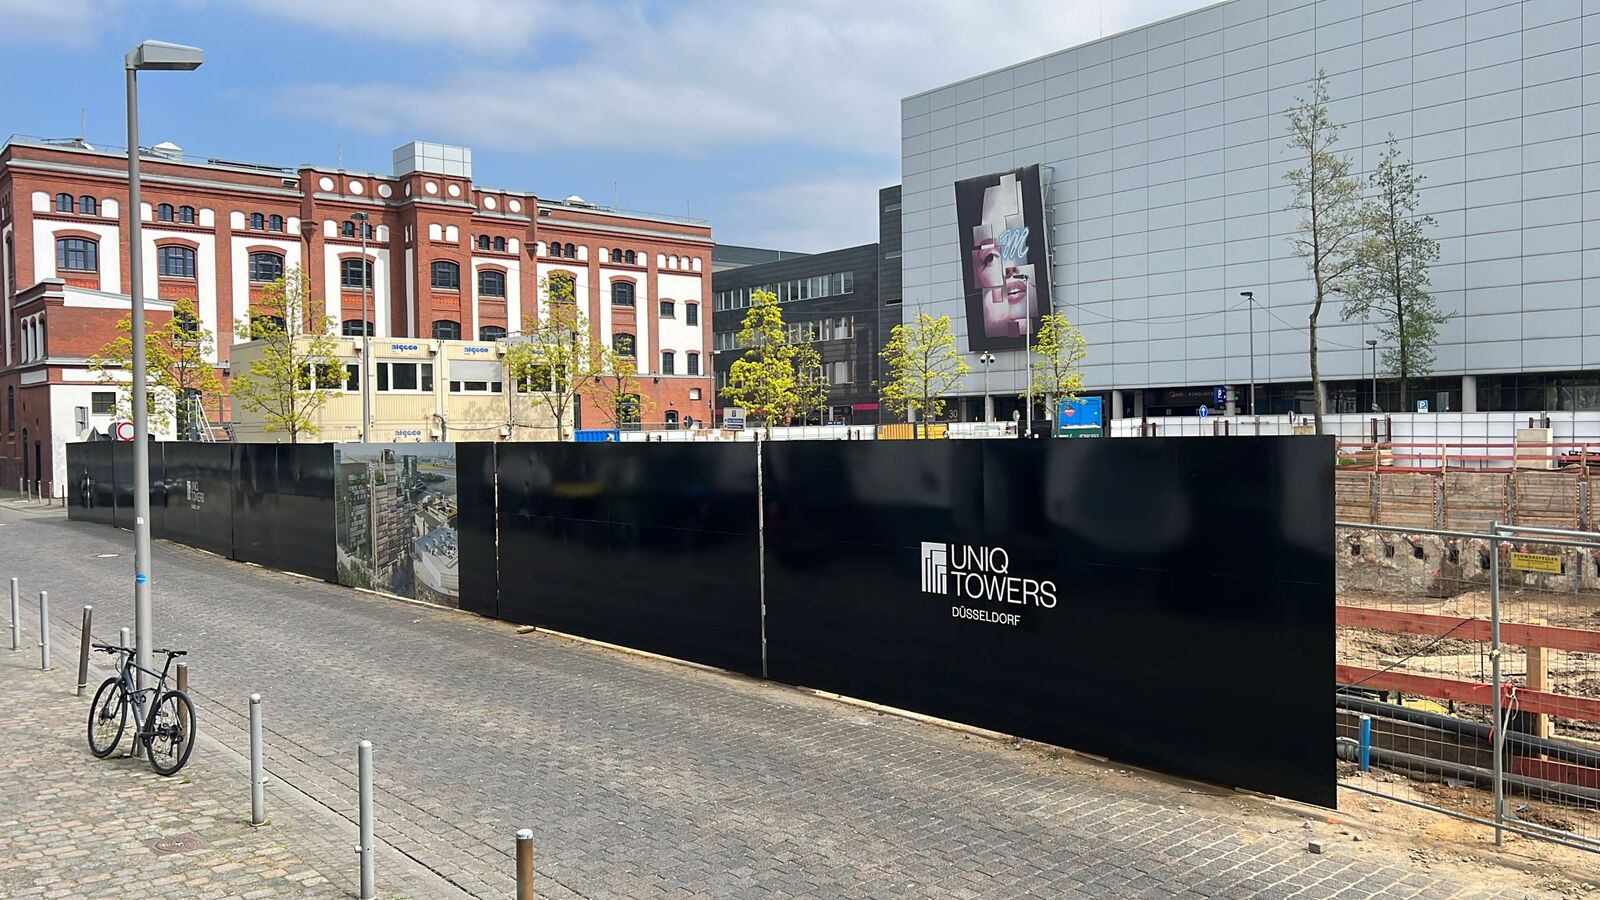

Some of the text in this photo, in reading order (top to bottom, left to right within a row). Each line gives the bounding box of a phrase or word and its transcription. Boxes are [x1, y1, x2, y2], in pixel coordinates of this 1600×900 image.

[949, 410, 957, 418] 30
[951, 543, 1009, 574] UNIQ
[951, 571, 1057, 608] TOWERS
[952, 606, 1021, 626] DÜSSELDORF
